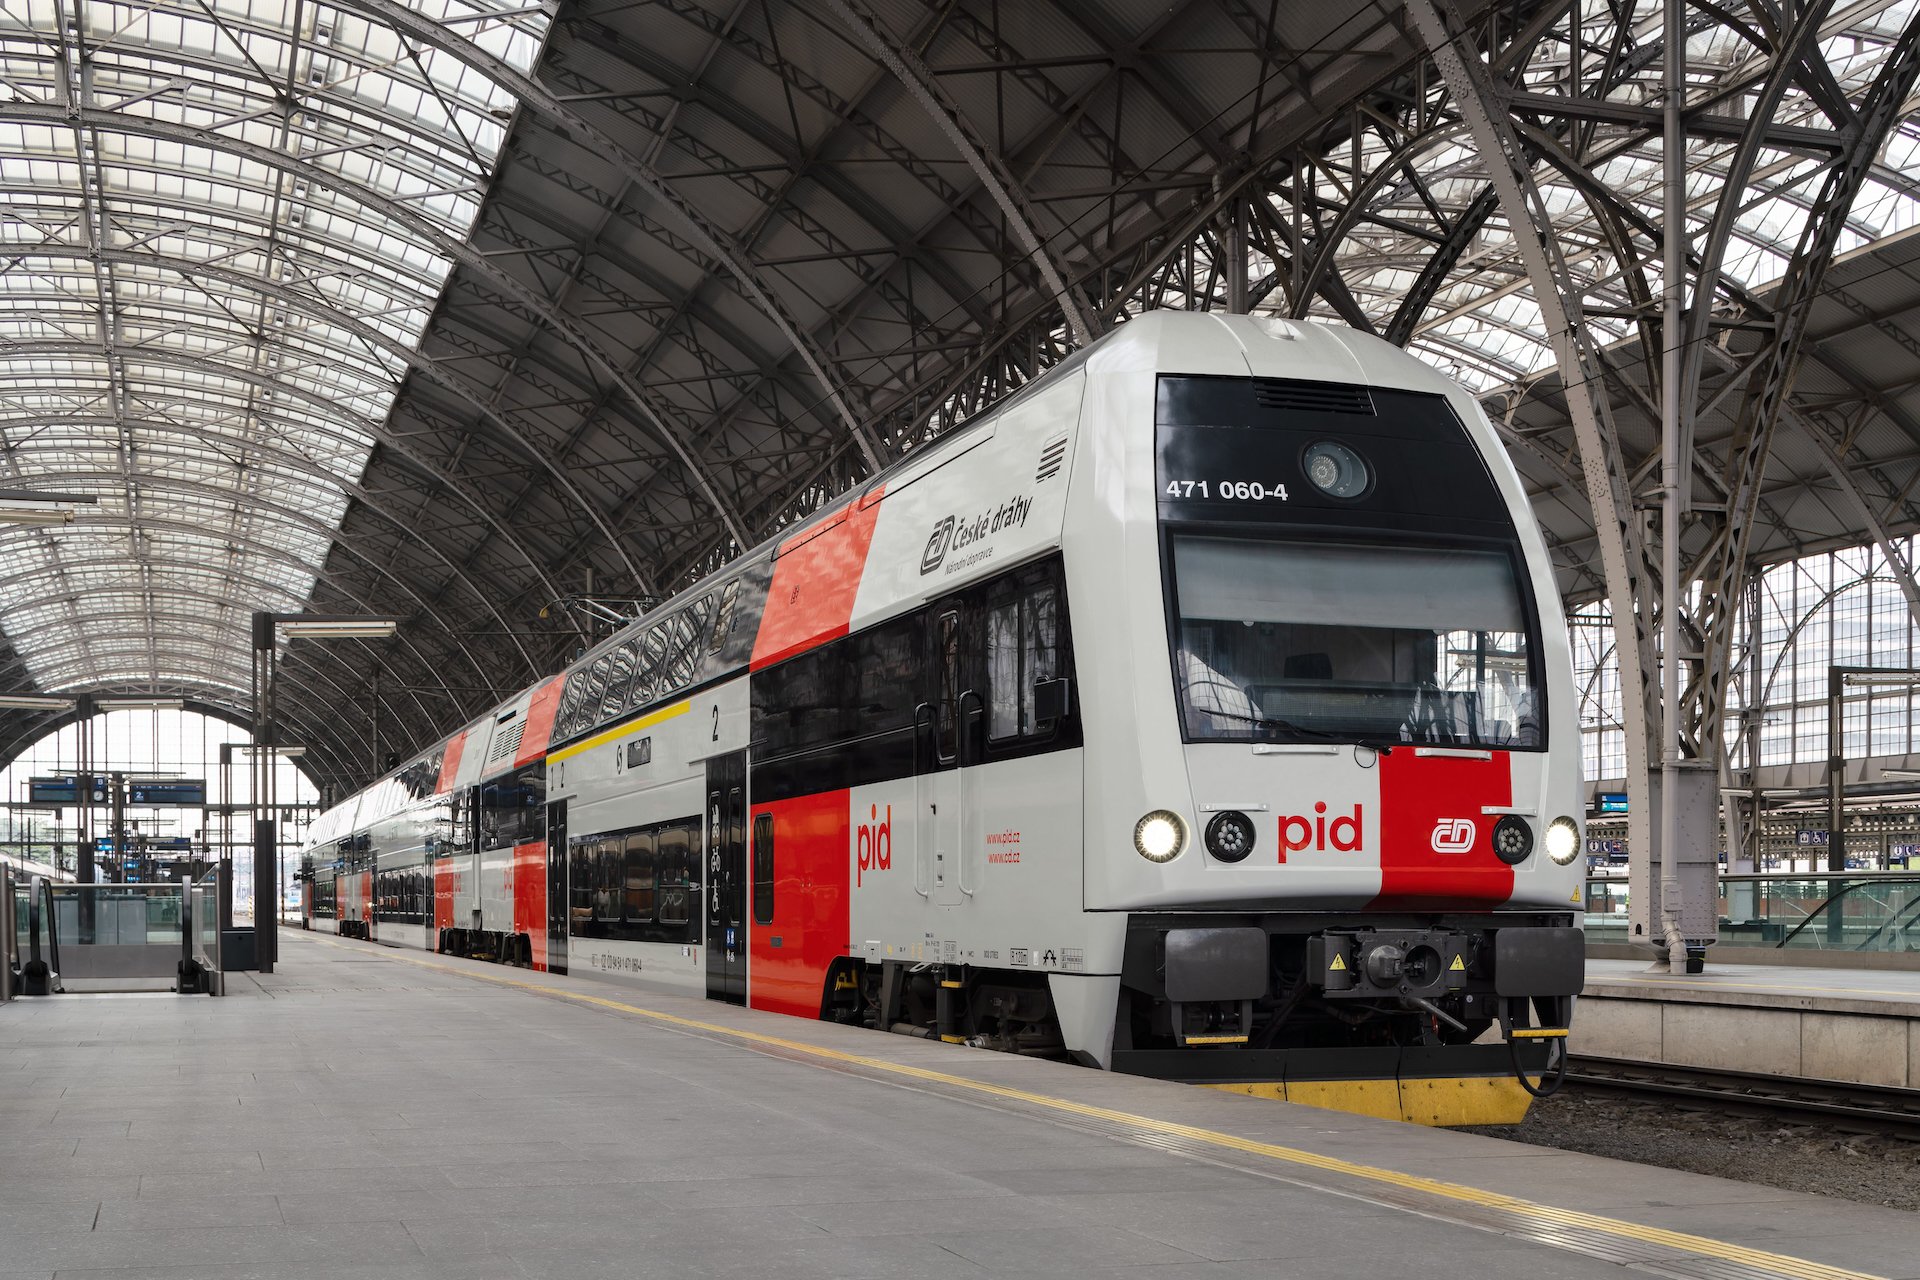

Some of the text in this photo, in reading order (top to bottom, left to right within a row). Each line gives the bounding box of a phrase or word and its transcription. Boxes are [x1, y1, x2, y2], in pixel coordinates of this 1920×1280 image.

[1166, 480, 1289, 501] 471 060-4
[952, 494, 1034, 552] České dráhy
[712, 704, 718, 741] 2
[560, 761, 565, 788] 2
[858, 804, 891, 888] pid
[986, 829, 1020, 847] www.pid.cz
[1278, 801, 1362, 864] pid
[988, 849, 1020, 864] www.cd.cz
